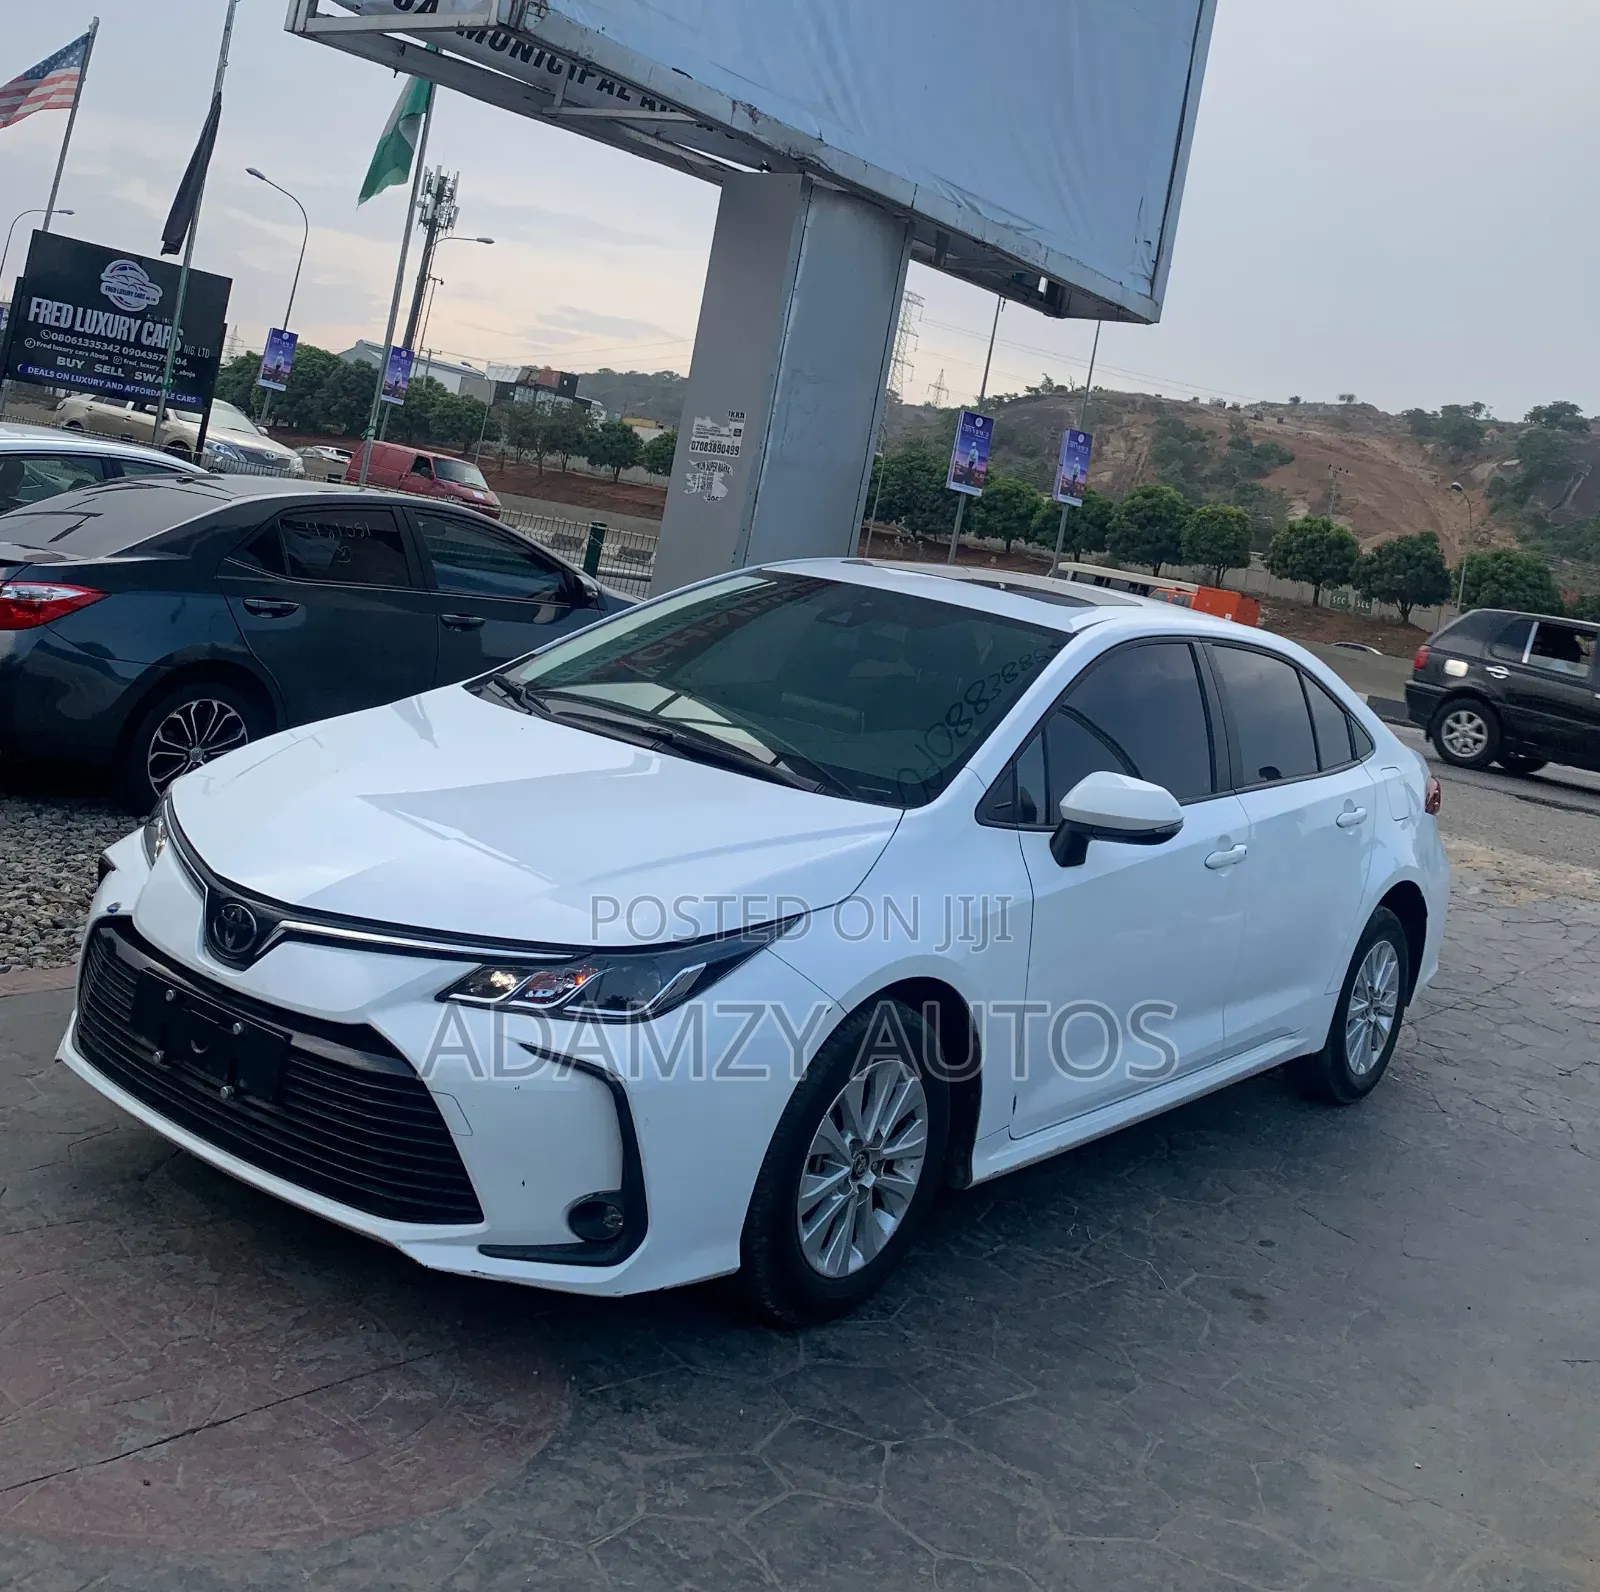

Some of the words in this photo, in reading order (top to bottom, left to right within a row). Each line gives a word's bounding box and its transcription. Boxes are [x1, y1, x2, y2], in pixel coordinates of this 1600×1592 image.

[28, 297, 74, 328] FRED
[74, 307, 142, 342] LUXURY
[51, 333, 120, 353] 08061335342
[56, 356, 86, 369] BUY
[94, 364, 125, 377] SELL
[27, 367, 56, 378] DEALS
[56, 372, 70, 381] ON
[71, 375, 105, 388] LUXURY
[105, 381, 124, 392] AND
[124, 384, 176, 400] AFFORDALE
[176, 394, 197, 404] CARS
